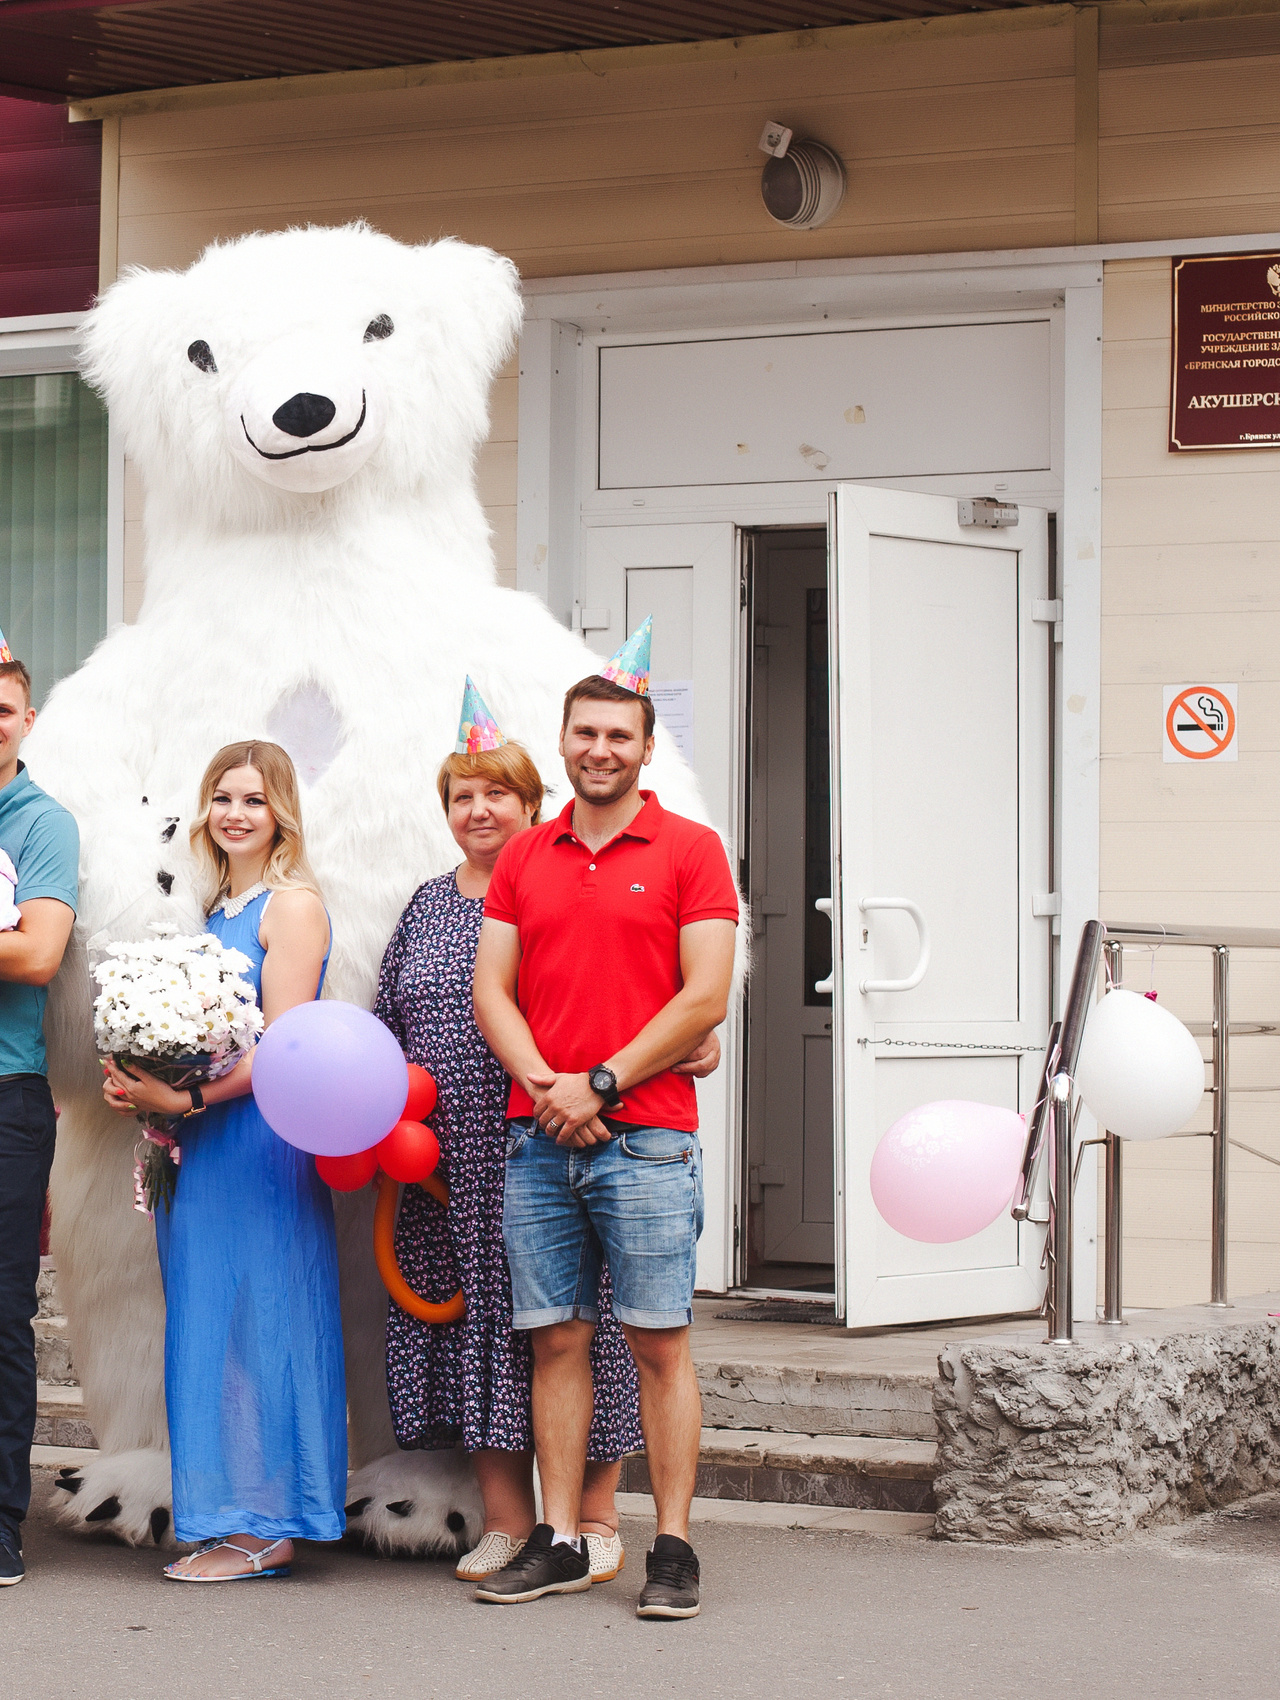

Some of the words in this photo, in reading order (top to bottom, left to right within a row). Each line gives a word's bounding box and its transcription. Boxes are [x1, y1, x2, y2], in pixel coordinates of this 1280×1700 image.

[1200, 301, 1276, 313] МИНИСТЕРСТВО
[1202, 331, 1280, 343] ГОСУДАРСТВЕН
[1200, 343, 1270, 354] УЧРЕЖДЕНИЕ
